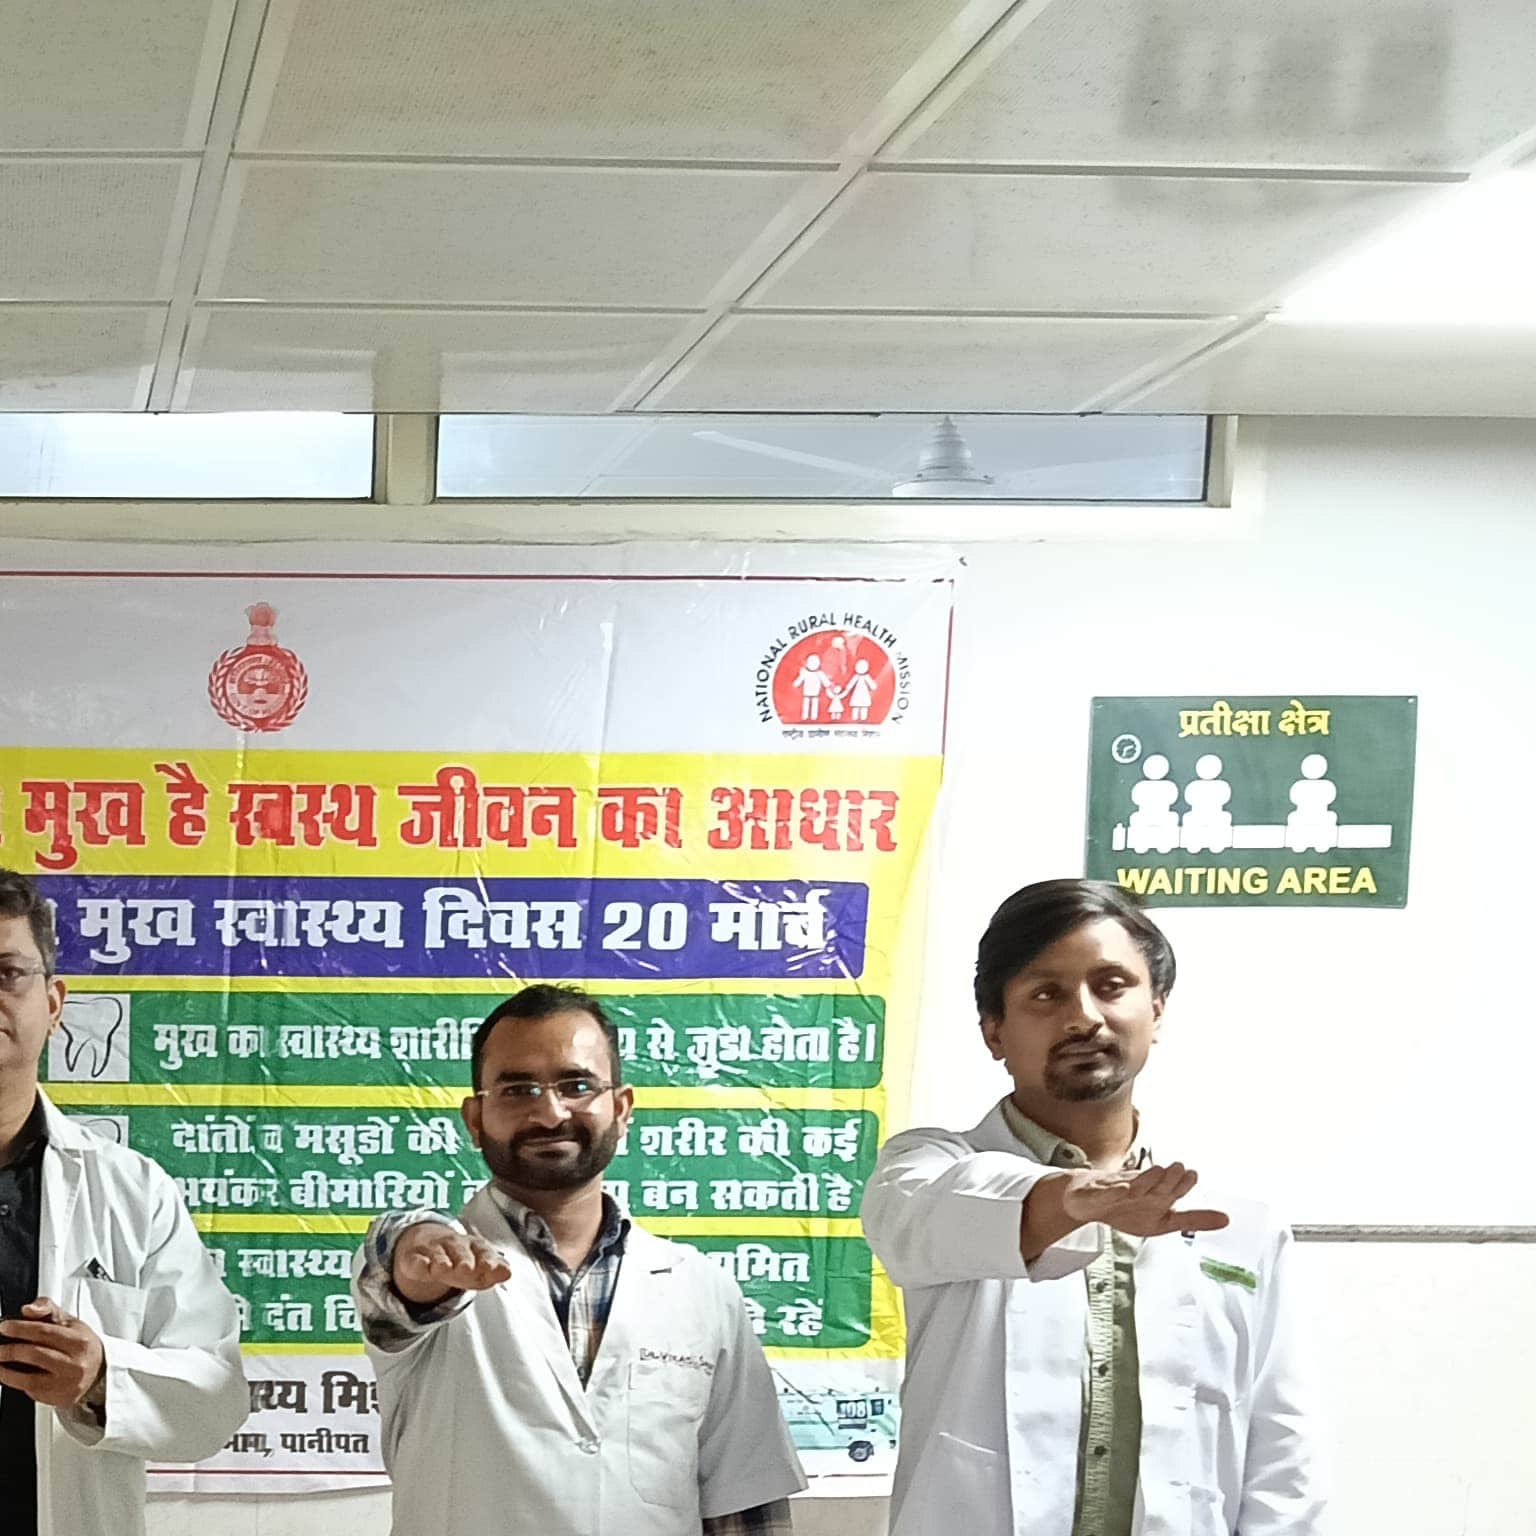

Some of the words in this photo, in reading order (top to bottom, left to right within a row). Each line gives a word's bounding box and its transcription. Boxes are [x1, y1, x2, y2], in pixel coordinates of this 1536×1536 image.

[755, 638, 788, 723] NATIONAL
[787, 612, 837, 640] RURAL
[843, 612, 897, 648] HEALTH
[891, 652, 912, 725] MISSION
[1178, 701, 1271, 738] प्रतीक्षा
[1278, 699, 1331, 736] क्षेत्र
[21, 781, 146, 870] मुख
[154, 762, 209, 846] है
[227, 783, 377, 847] स्वस्थ
[397, 766, 578, 849] जीवन
[598, 786, 683, 849] का
[707, 786, 900, 852] आधार
[1117, 867, 1268, 895] WAITING
[1276, 867, 1377, 894] AREA
[76, 898, 197, 964] मुख
[214, 899, 405, 948] स्वास्थ्य
[422, 886, 583, 949] दिवस
[602, 902, 688, 950] 20
[708, 889, 832, 950] मार्च
[153, 1024, 218, 1070] मुख
[227, 1024, 265, 1059] का
[279, 1024, 382, 1060] स्वास्थ्य
[760, 1014, 829, 1062] होता
[171, 1115, 255, 1154] दांतों
[259, 1124, 283, 1153] व
[407, 1117, 459, 1154] की
[640, 1117, 727, 1156] शरीर
[737, 1118, 790, 1156] की
[802, 1118, 862, 1162] कई
[289, 1170, 455, 1209] बीमारियों
[641, 1180, 699, 1210] बन
[710, 1173, 820, 1211] सकती
[822, 1173, 853, 1211] है
[237, 1249, 353, 1278] स्वास्थ्य
[265, 1294, 313, 1332] दंत
[776, 1297, 824, 1336] रहें
[280, 1427, 370, 1454] पानीपत
